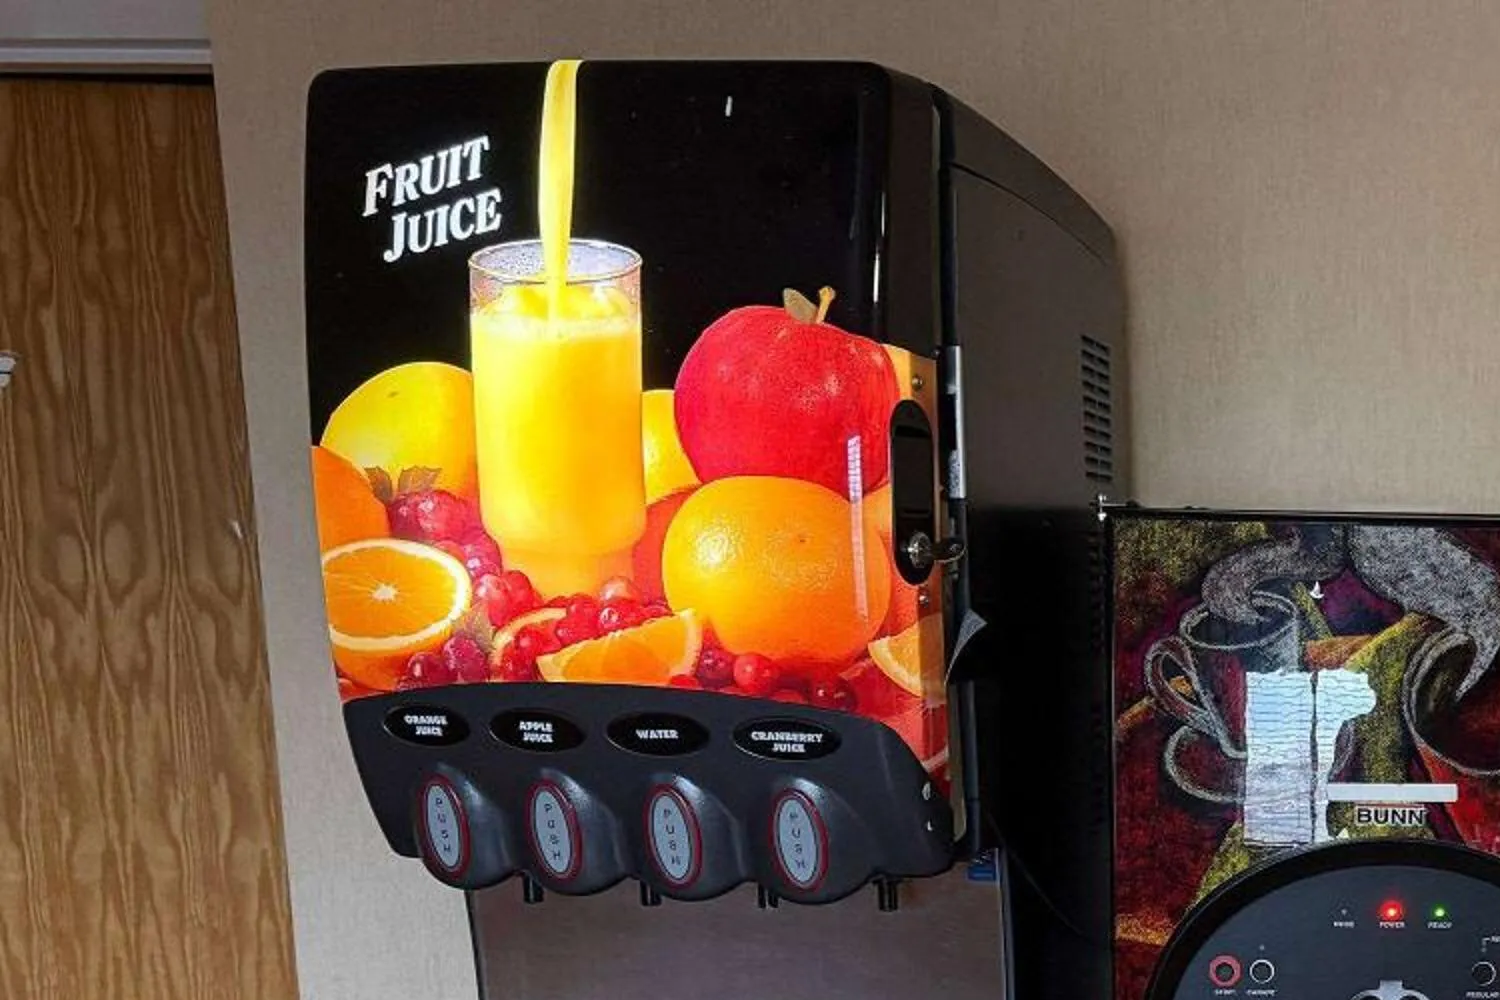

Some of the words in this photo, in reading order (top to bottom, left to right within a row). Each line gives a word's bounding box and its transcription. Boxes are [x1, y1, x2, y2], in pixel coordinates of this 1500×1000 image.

[362, 134, 490, 217] FRUIT
[383, 187, 502, 263] JUICE
[403, 714, 448, 725] ORANGE
[415, 726, 443, 736] JUICE
[519, 721, 553, 732] APPLE
[523, 732, 554, 743] JUICE
[636, 729, 679, 739] WATER
[751, 731, 824, 743] CRANBERRY
[772, 743, 806, 753] JUICE
[1357, 807, 1425, 826] BUNN
